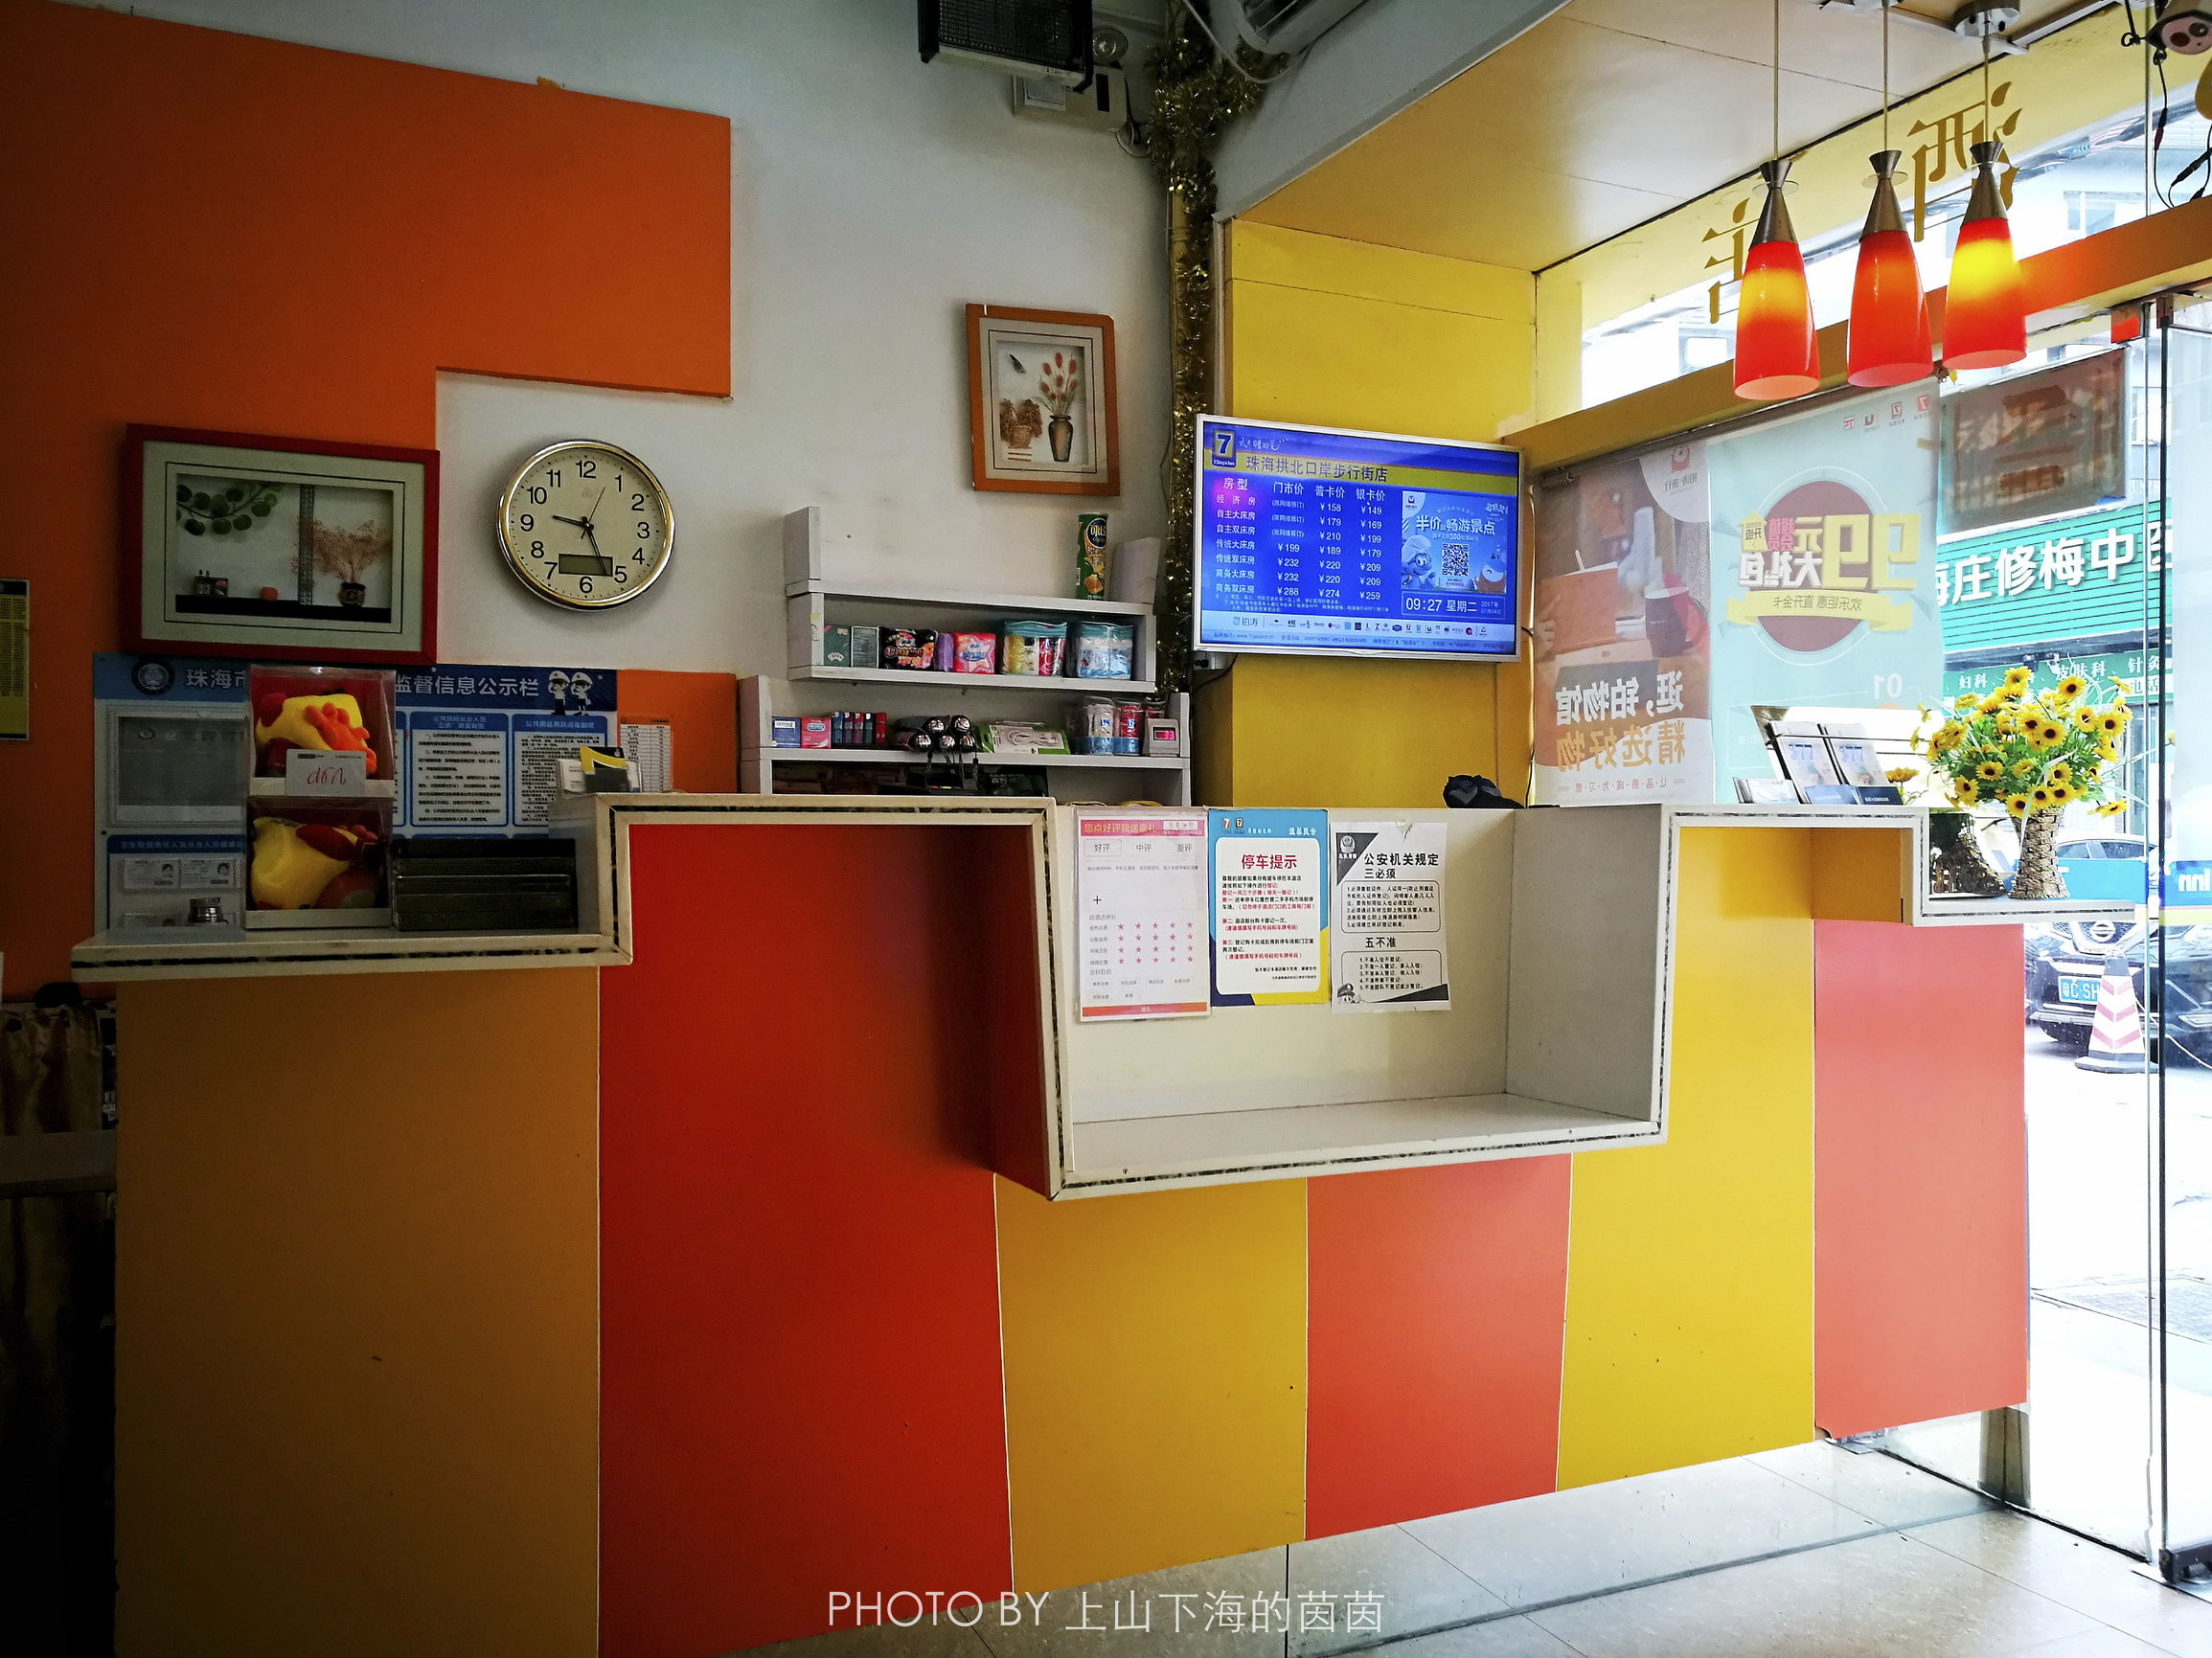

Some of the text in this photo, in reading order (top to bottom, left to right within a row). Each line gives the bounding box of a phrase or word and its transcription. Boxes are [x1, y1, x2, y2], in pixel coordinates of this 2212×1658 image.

[1216, 432, 1233, 455] 7
[576, 460, 596, 479] 12
[1245, 455, 1387, 483] 珠海拱北口岸步行街店
[546, 469, 561, 488] 11
[615, 474, 623, 492] 1
[527, 486, 547, 505] 10
[1223, 478, 1385, 501] 房型 门市价 普卡价 银卡价
[630, 493, 645, 511] 2
[1360, 506, 1382, 515] ¥149
[520, 513, 535, 532] 9
[1217, 510, 1255, 520] 自主大床房
[1320, 517, 1341, 527] ¥179
[1360, 520, 1382, 530] ¥169
[636, 521, 650, 539] 3
[1217, 524, 1255, 535] 自主双床房
[1319, 531, 1341, 541] ¥210
[1360, 534, 1382, 543] ¥199
[530, 540, 545, 558] 8
[631, 547, 646, 565] 4
[1216, 538, 1381, 557] 传统大床房 ¥199 ¥189 ¥179
[544, 561, 559, 579] 7
[1216, 553, 1381, 572] 传统双床房 ¥232 ¥220 ¥209
[614, 565, 627, 583] 5
[1216, 568, 1381, 586] 商务大床房 ¥232 ¥220 ¥209
[579, 576, 593, 594] 6
[1216, 582, 1254, 594] 商务双床房
[1318, 589, 1340, 598] ¥274
[1359, 591, 1381, 601] ¥259
[1405, 597, 1442, 611] 09:27
[1446, 600, 1477, 613] 星期二
[396, 674, 539, 698] 监督信息公示栏
[1958, 672, 1988, 690] 妇科
[1094, 843, 1110, 852] 好评
[1136, 843, 1152, 852] 中评
[1242, 854, 1297, 870] 停车提示
[1364, 852, 1439, 866] 公安机关规定
[1364, 868, 1396, 879] 三必须
[1365, 937, 1397, 948] 五不准
